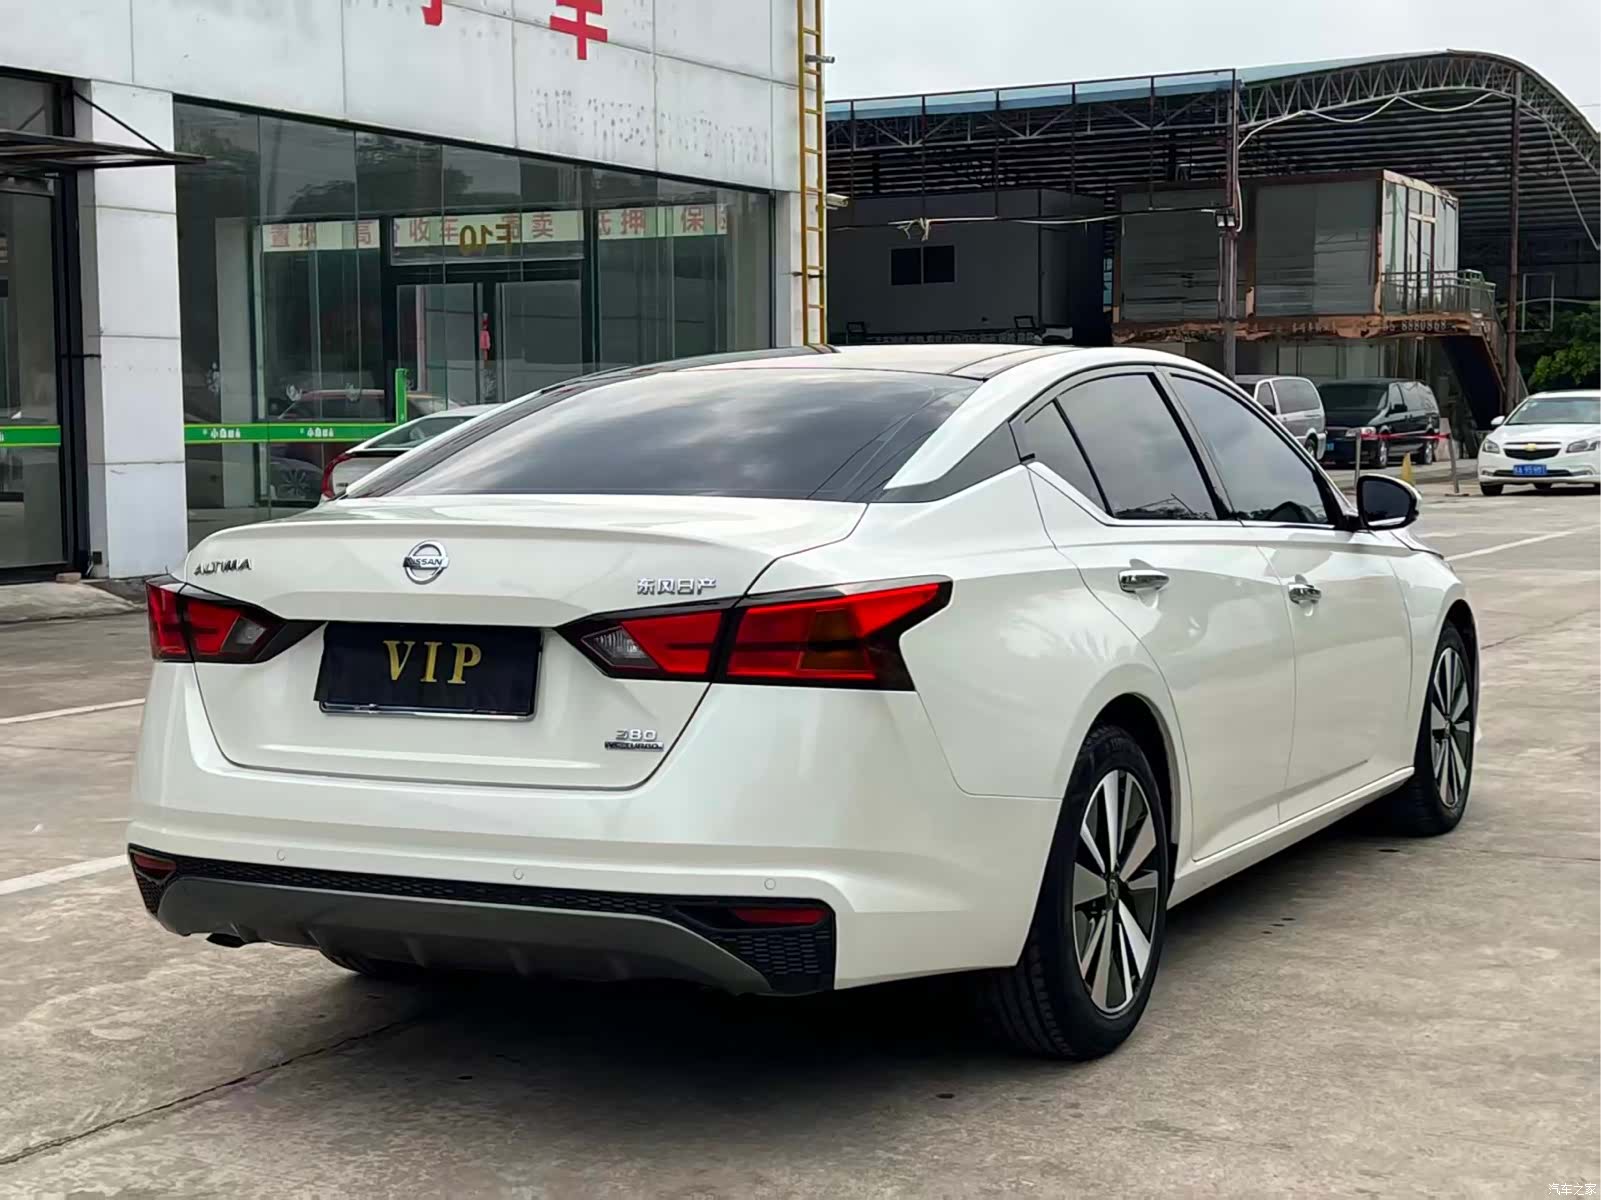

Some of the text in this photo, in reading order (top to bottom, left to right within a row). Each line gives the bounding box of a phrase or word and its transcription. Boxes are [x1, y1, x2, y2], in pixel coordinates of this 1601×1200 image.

[421, 0, 608, 60] 车
[193, 558, 252, 576] ALTIMA
[637, 577, 717, 595] 东风日产
[383, 640, 482, 685] VIP
